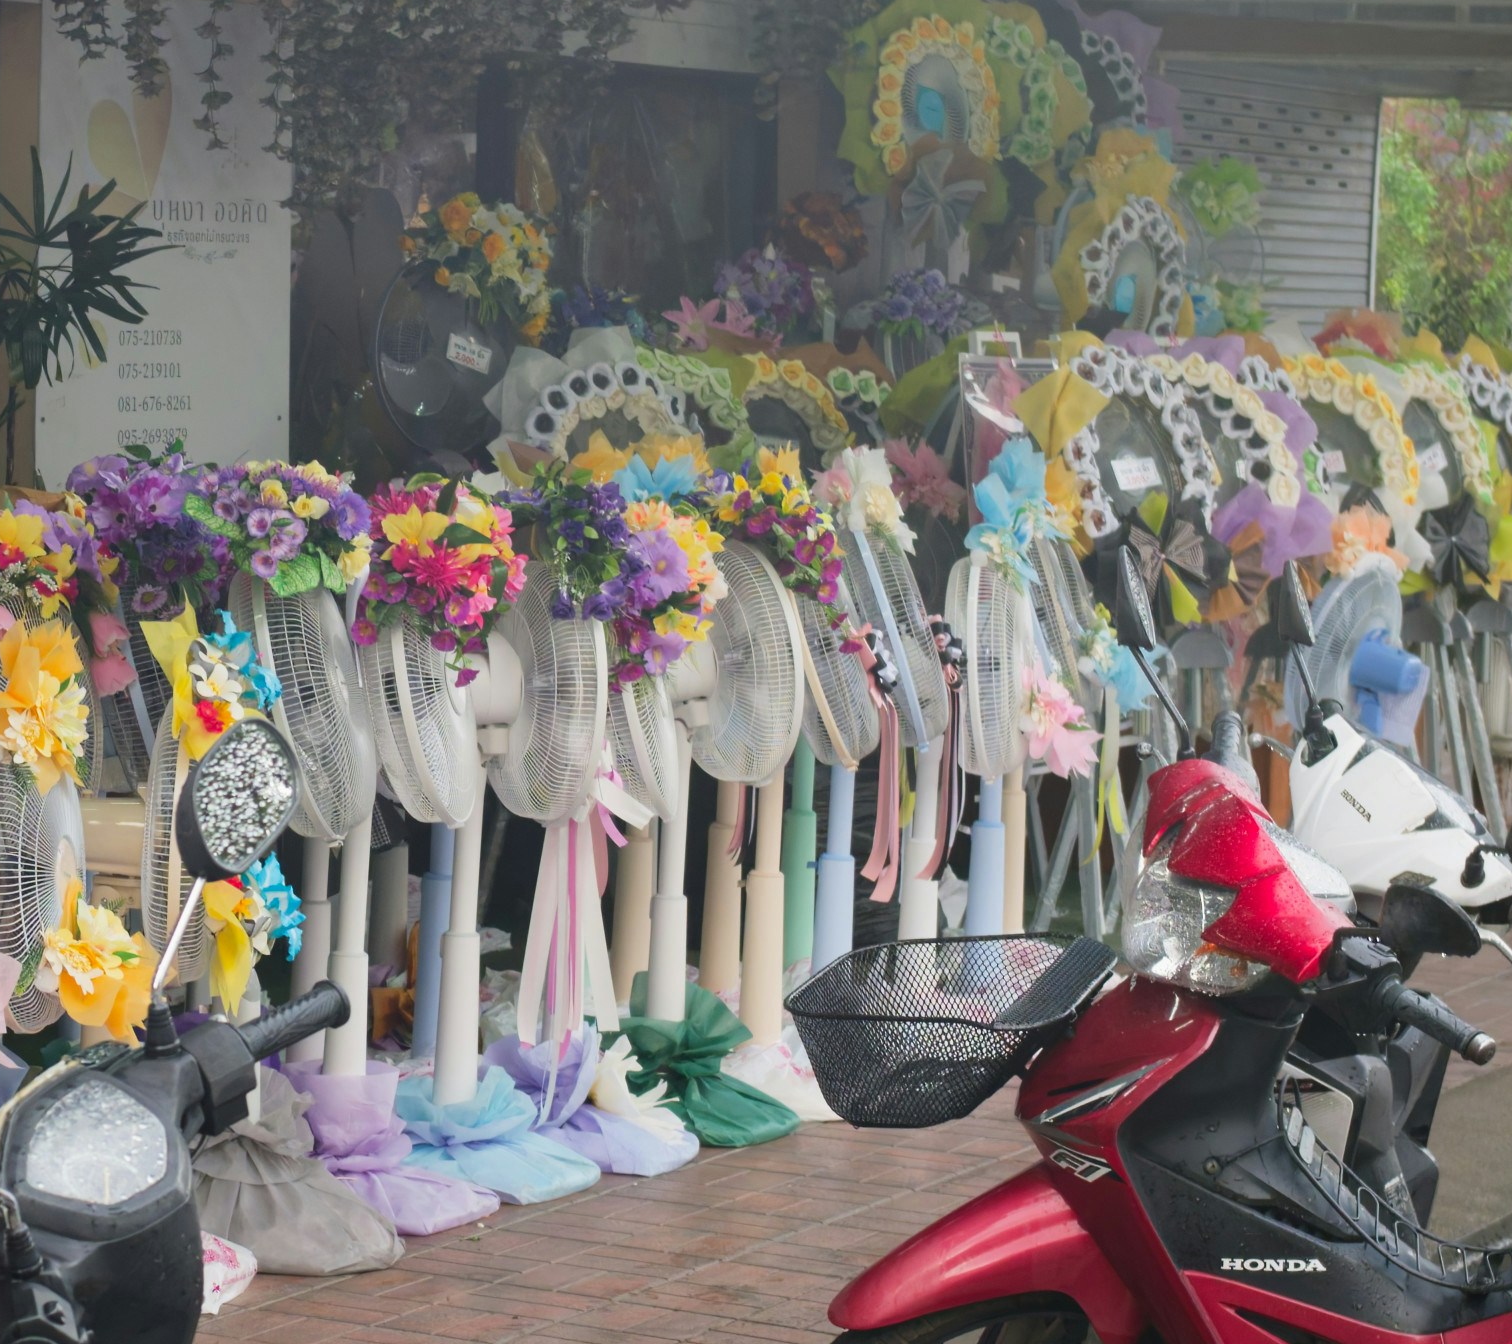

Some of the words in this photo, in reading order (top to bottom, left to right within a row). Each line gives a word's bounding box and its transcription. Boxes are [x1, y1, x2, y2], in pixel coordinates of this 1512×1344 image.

[152, 199, 204, 231] บุหงา
[118, 329, 182, 346] 075-210738
[117, 362, 182, 380] 075-219101
[117, 395, 192, 413] 081-676-8261
[117, 427, 188, 446] 095-2693879
[1340, 788, 1372, 823] HONDA
[1221, 1257, 1327, 1272] HONDA
